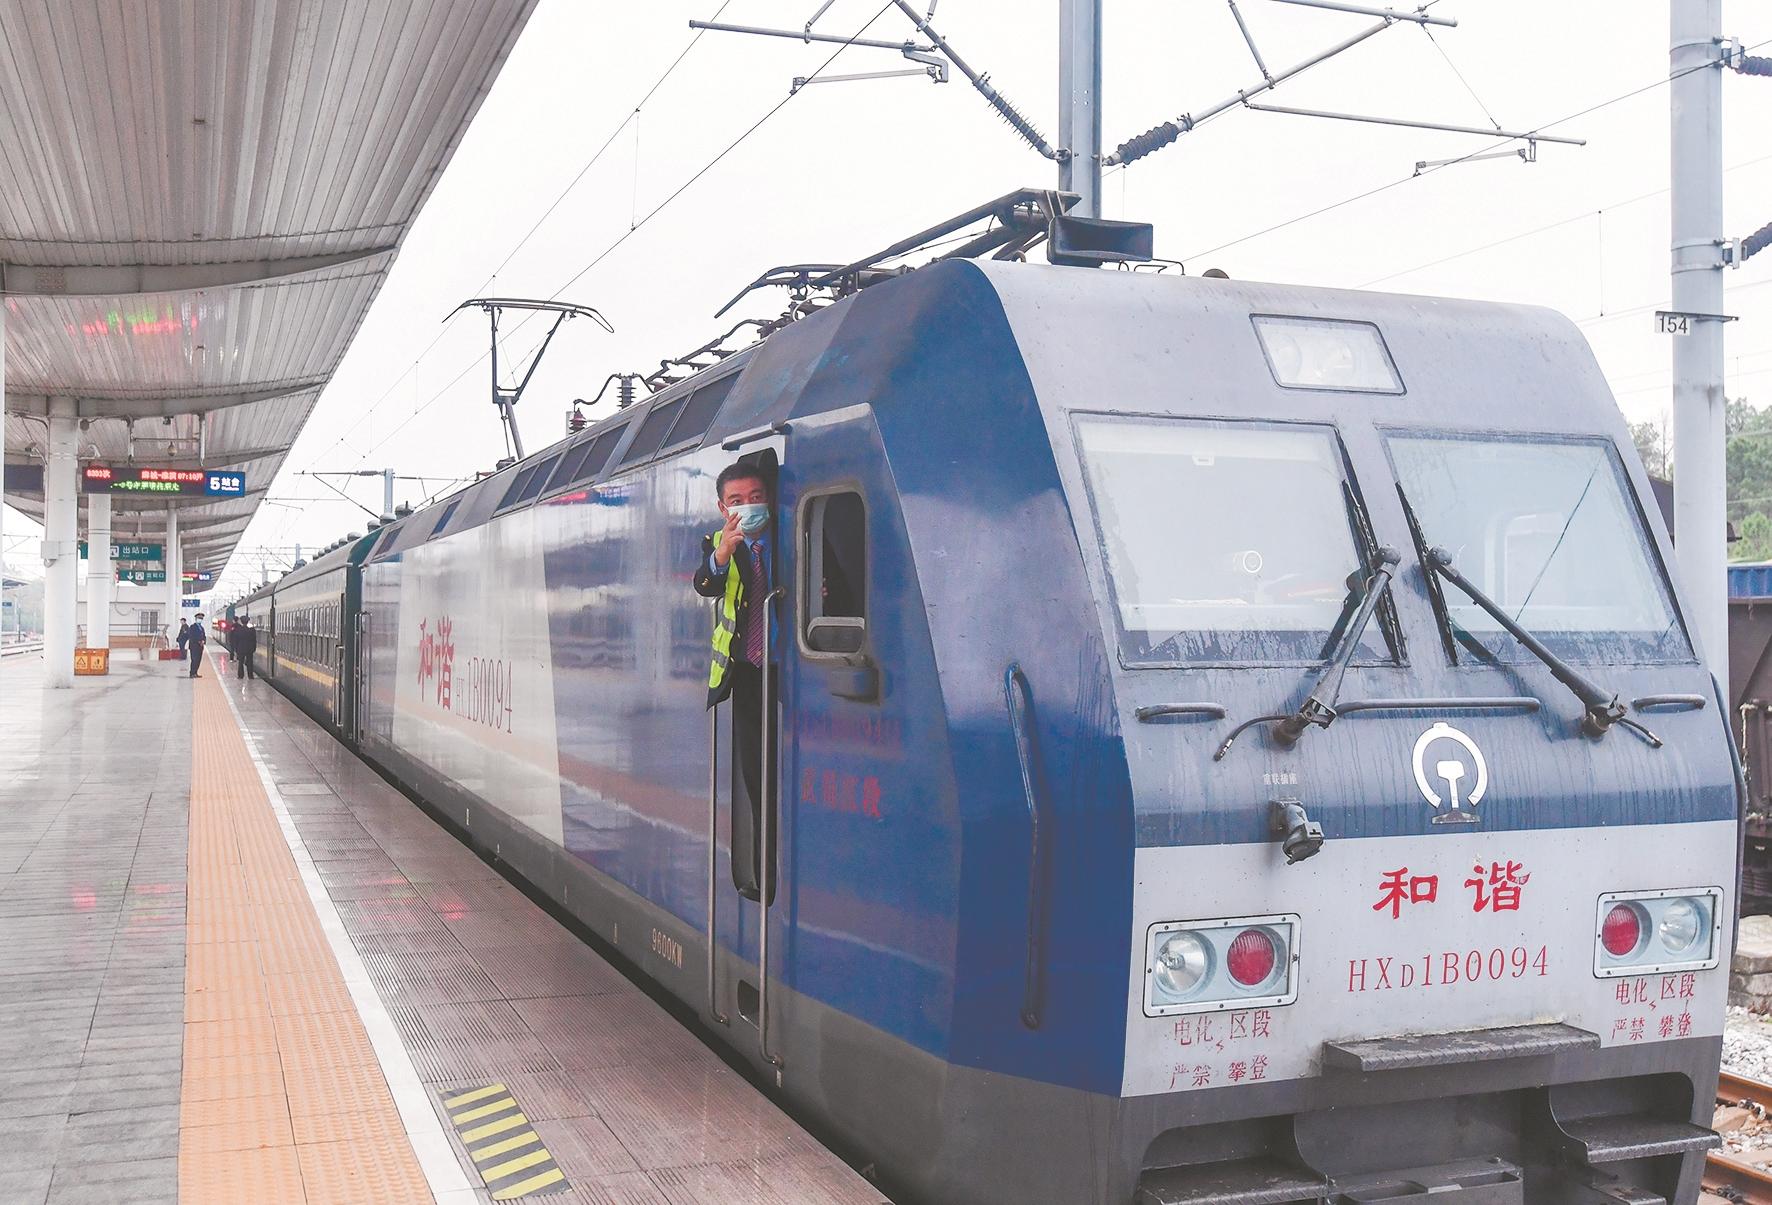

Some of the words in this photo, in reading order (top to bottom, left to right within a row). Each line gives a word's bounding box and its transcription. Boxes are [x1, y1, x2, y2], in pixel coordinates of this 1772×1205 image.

[1660, 315, 1688, 334] 154
[210, 477, 220, 490] 5
[123, 545, 149, 555] 出站口
[418, 615, 454, 711] 和谐
[1372, 860, 1531, 919] 和谐
